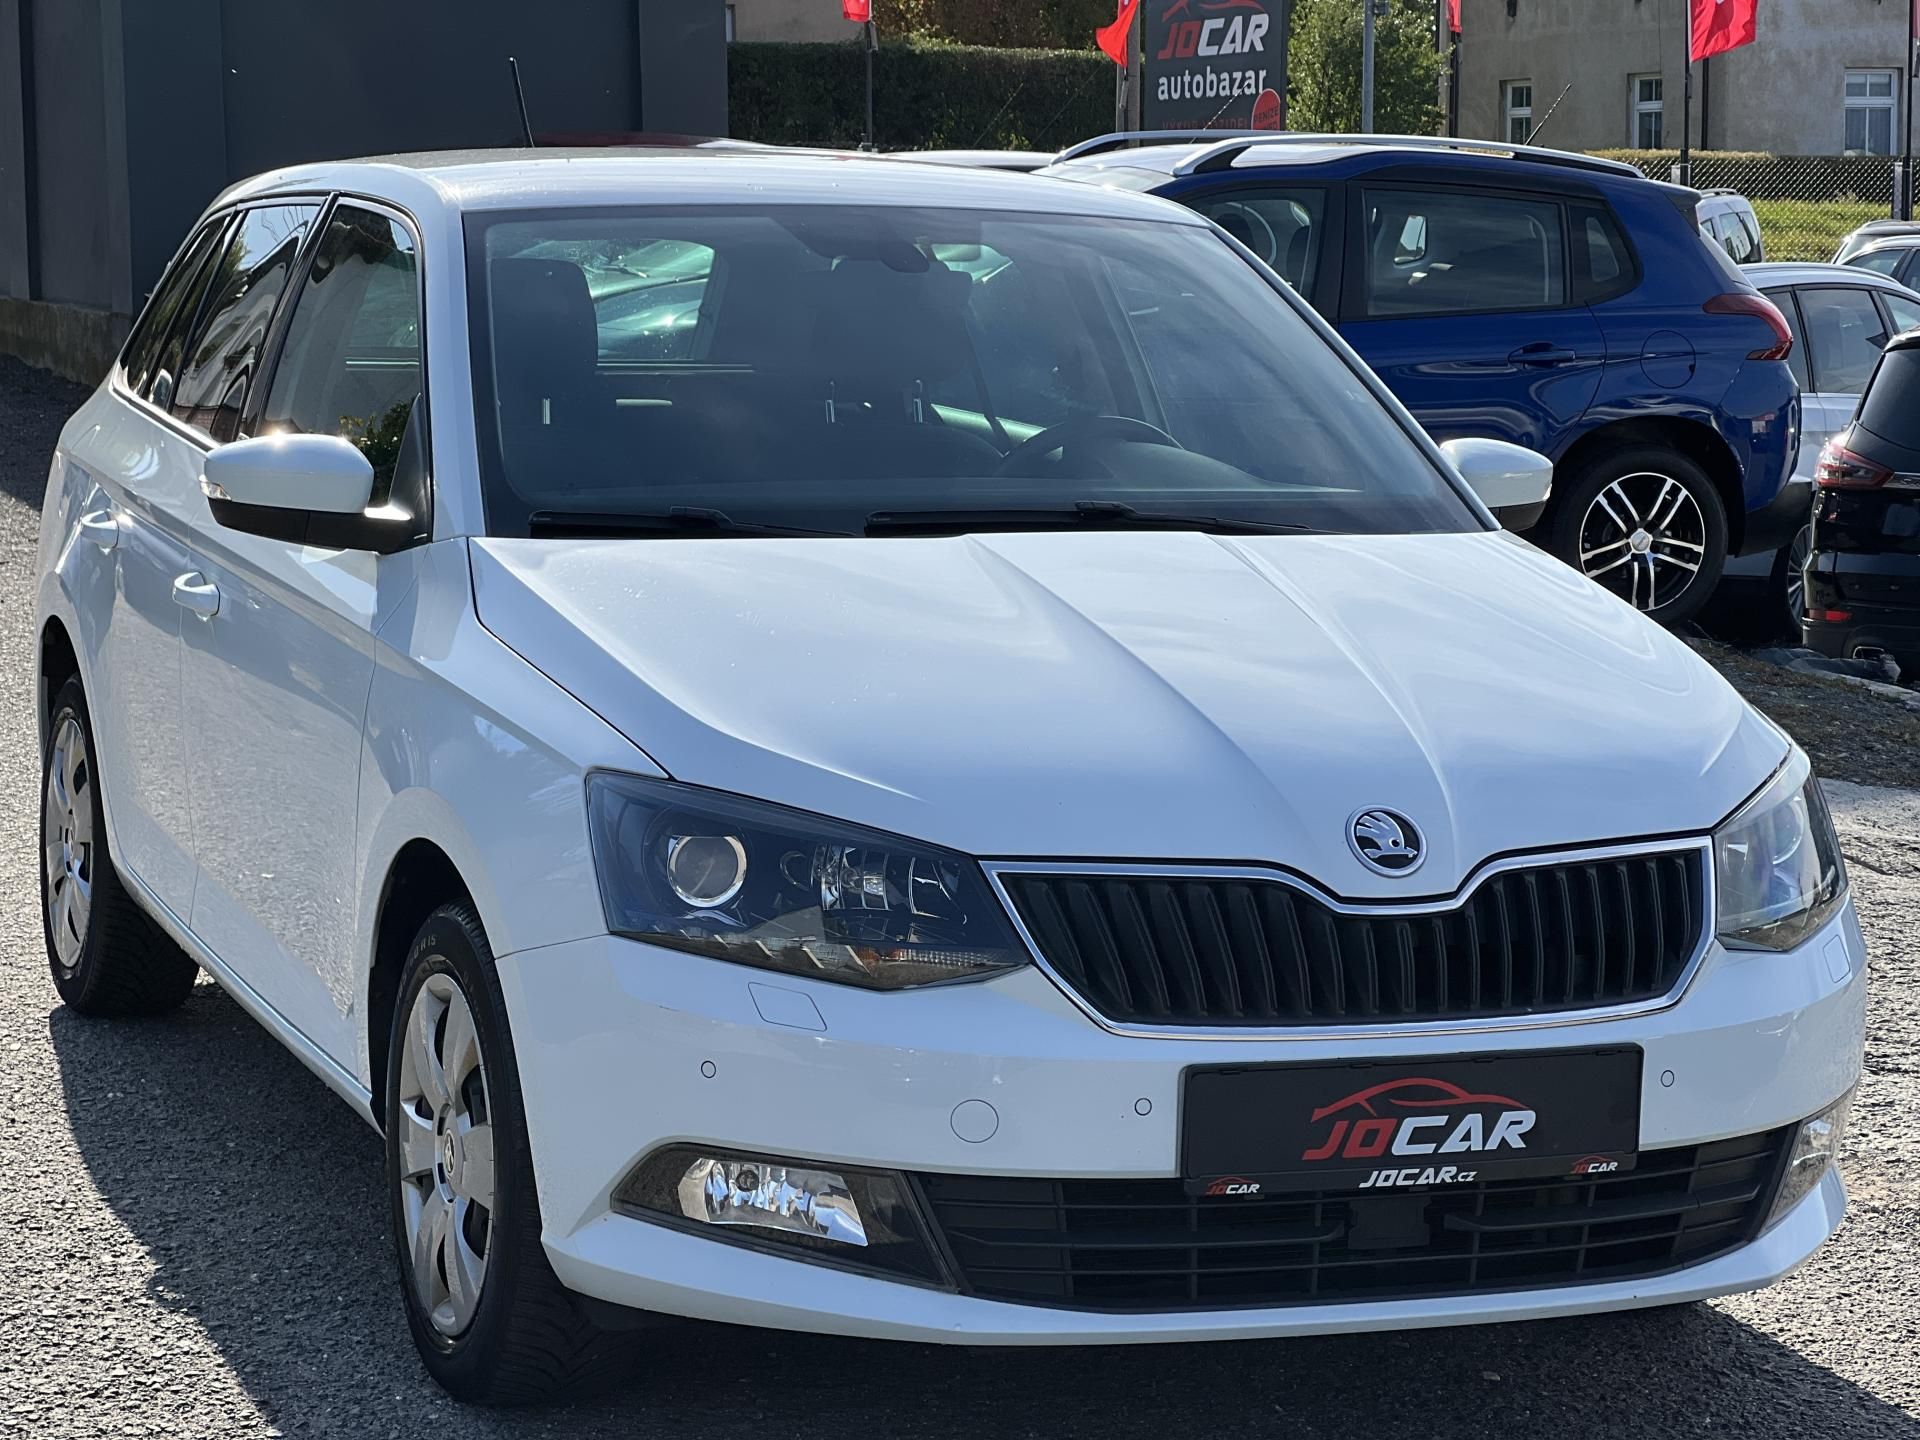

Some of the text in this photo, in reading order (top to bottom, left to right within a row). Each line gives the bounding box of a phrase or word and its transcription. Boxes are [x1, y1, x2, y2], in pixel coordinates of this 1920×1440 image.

[1157, 14, 1269, 60] JOCAR
[1158, 66, 1267, 100] autobazar
[1302, 1110, 1536, 1161] JOCAR
[1570, 1161, 1618, 1174] JOCAR
[1206, 1183, 1261, 1195] JOCAR
